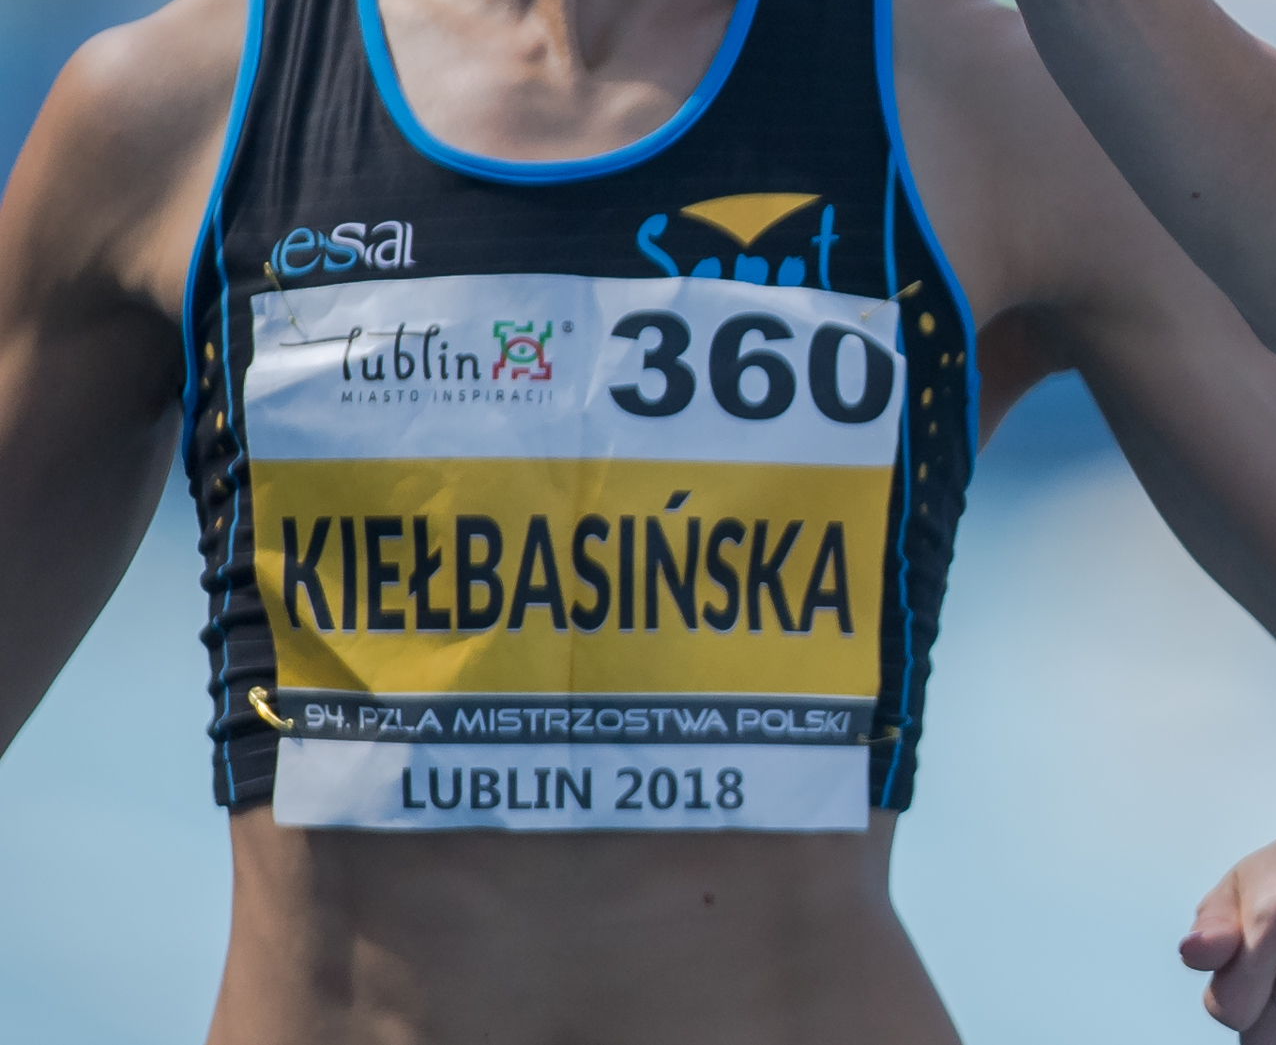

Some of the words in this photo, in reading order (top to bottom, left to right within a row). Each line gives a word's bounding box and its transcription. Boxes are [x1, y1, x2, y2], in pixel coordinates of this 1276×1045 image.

[280, 322, 480, 380] lublin
[608, 309, 895, 424] 360
[341, 390, 419, 402] MIASTO
[434, 390, 553, 403] INSPIRACJI
[281, 491, 856, 635] KIEŁBASIŃSKA
[304, 704, 350, 728] 94.
[358, 706, 443, 732] PZLA
[453, 708, 728, 734] MISTRZOSTWA
[736, 708, 850, 734] POLSKI
[402, 767, 594, 810] LUBLIN
[614, 767, 745, 811] 2018
